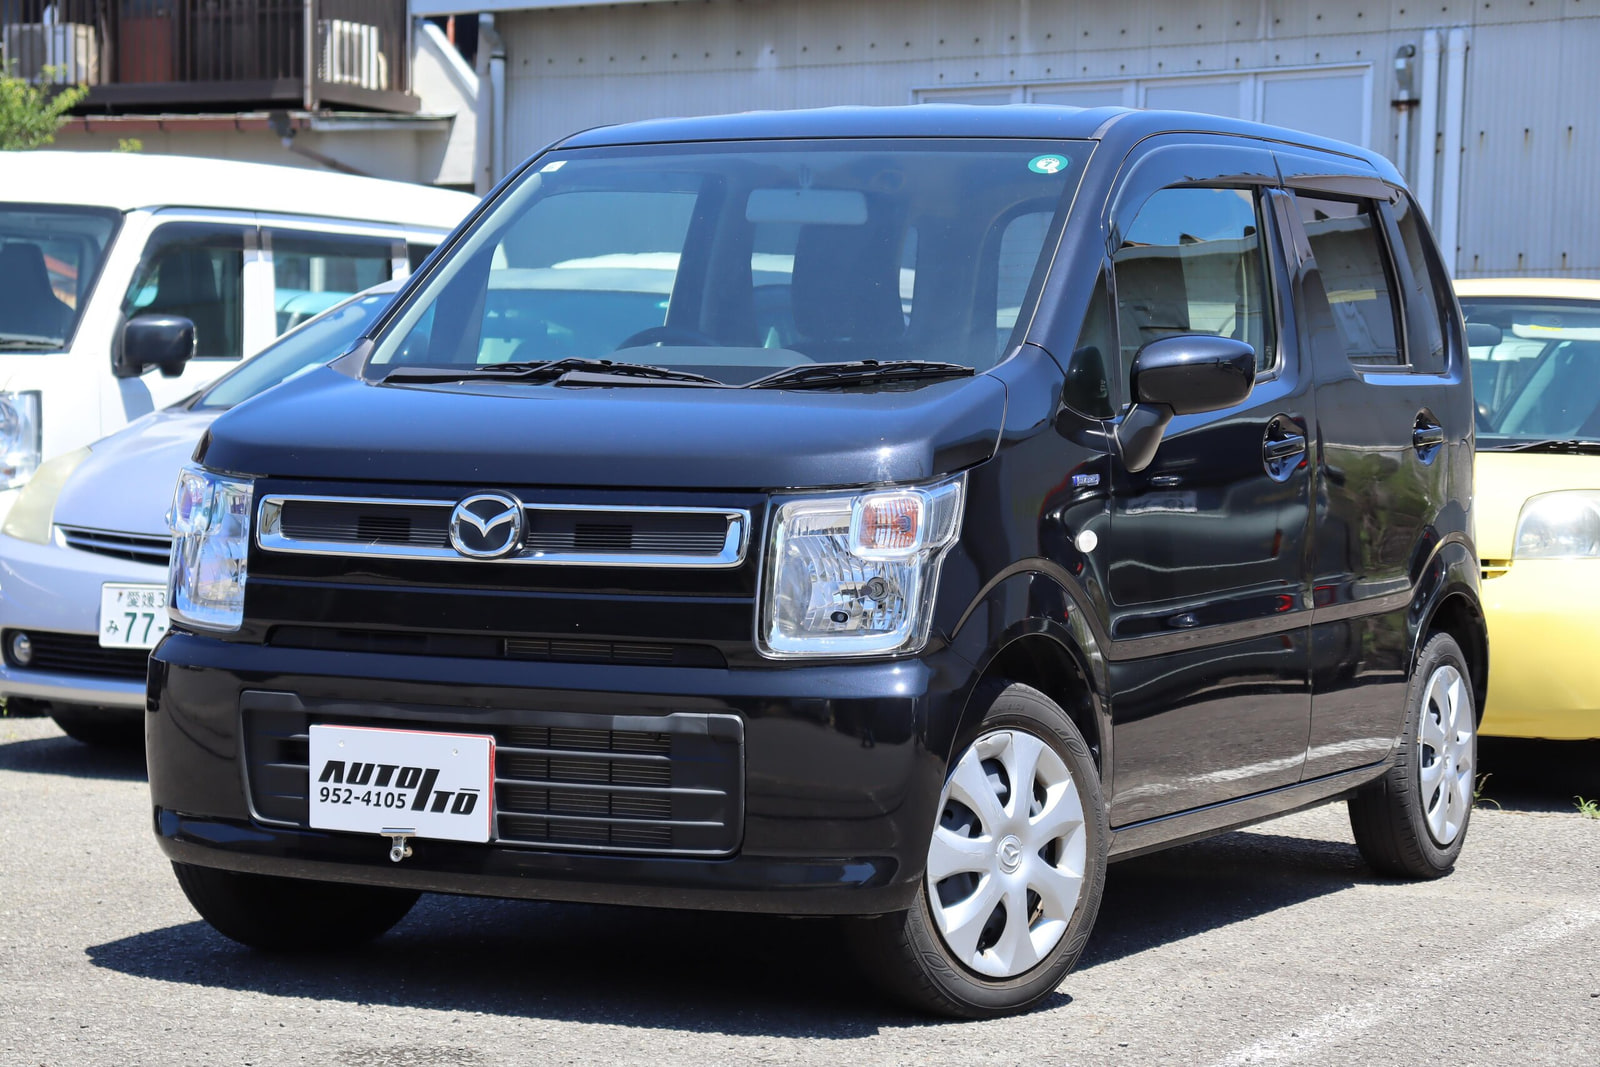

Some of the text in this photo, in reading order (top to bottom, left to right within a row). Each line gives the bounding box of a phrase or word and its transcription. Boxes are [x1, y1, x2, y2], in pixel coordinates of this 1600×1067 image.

[105, 620, 119, 635] み
[318, 760, 423, 789] AUTO
[319, 786, 407, 809] 952-4105
